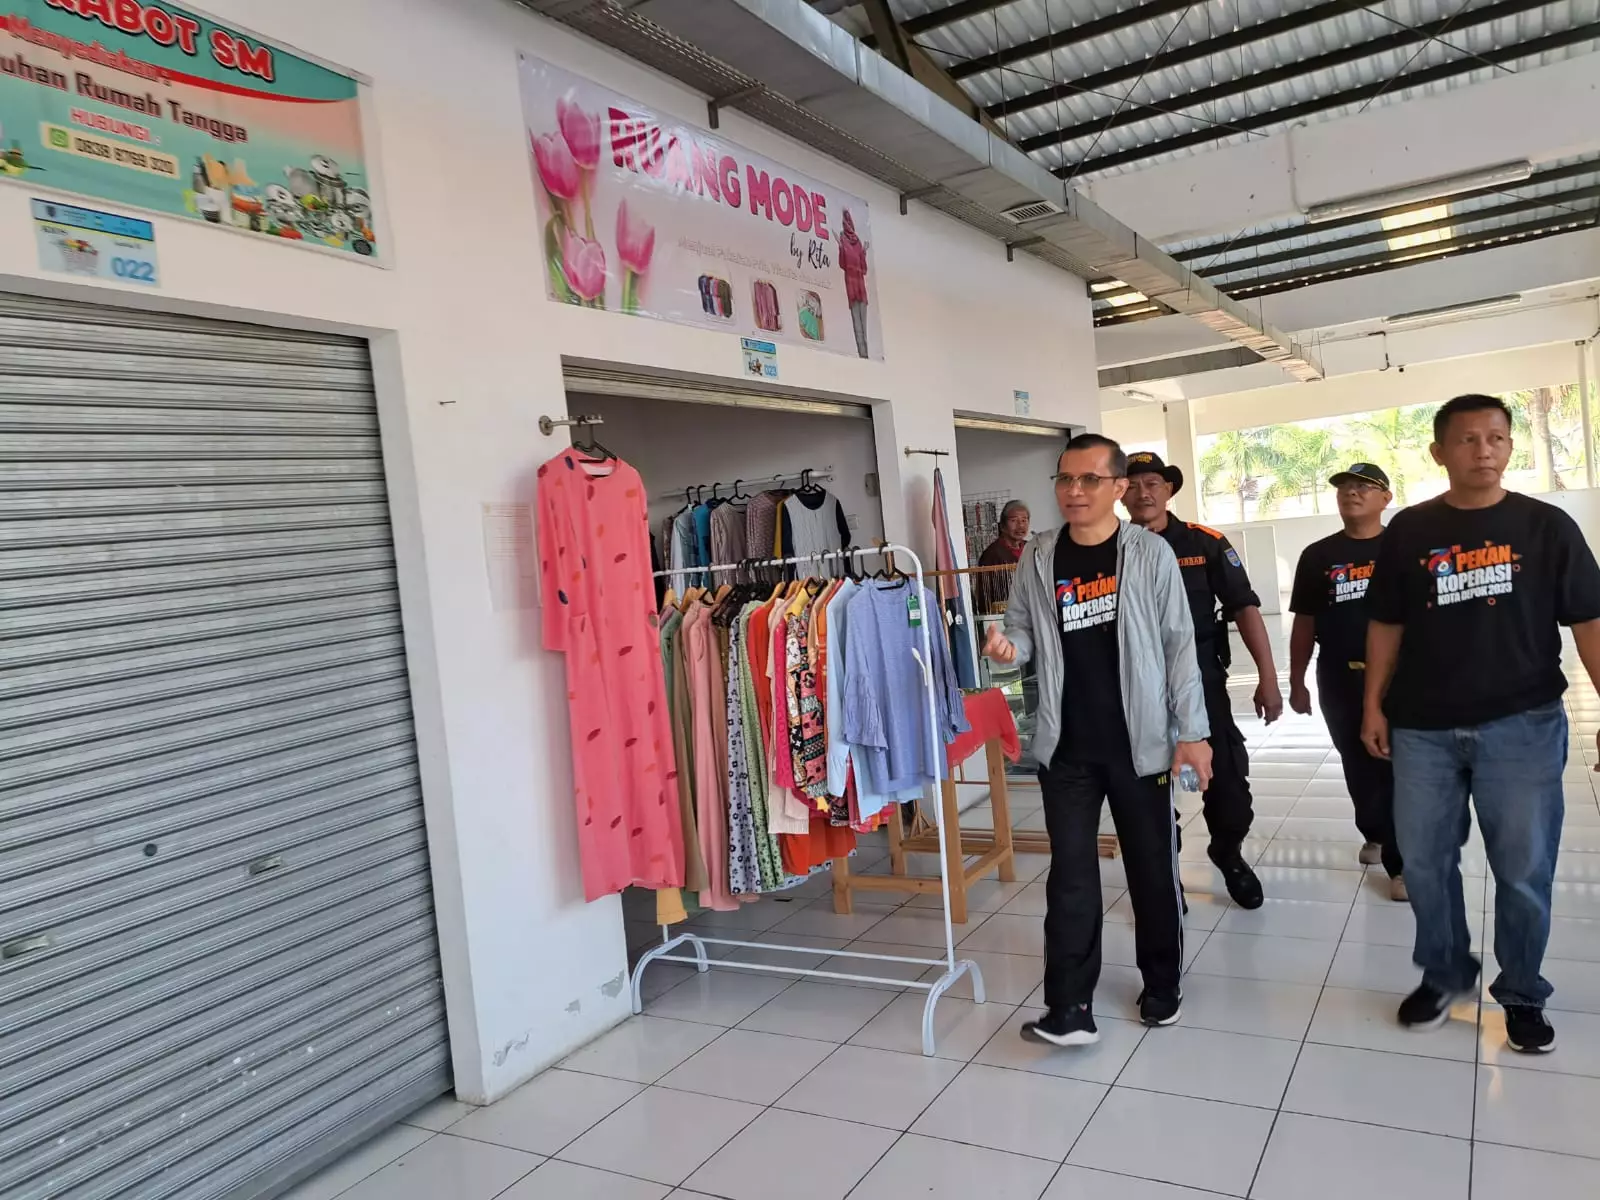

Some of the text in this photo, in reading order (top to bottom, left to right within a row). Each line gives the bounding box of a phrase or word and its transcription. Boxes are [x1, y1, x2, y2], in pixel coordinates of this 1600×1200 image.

[210, 29, 275, 83] SM
[74, 71, 162, 118] Rumah
[167, 98, 249, 144] Tangga
[608, 107, 831, 240] RUANG MODE
[790, 233, 831, 269] by Rita
[112, 257, 156, 282] 022
[1456, 545, 1511, 572] PEKAN
[1077, 576, 1117, 602] PEKAN
[1336, 579, 1369, 596] KOPER
[1437, 563, 1512, 594] KOPERASI
[1062, 593, 1117, 623] KOPERASI
[1437, 592, 1461, 606] KOTA
[1487, 582, 1512, 596] 2023
